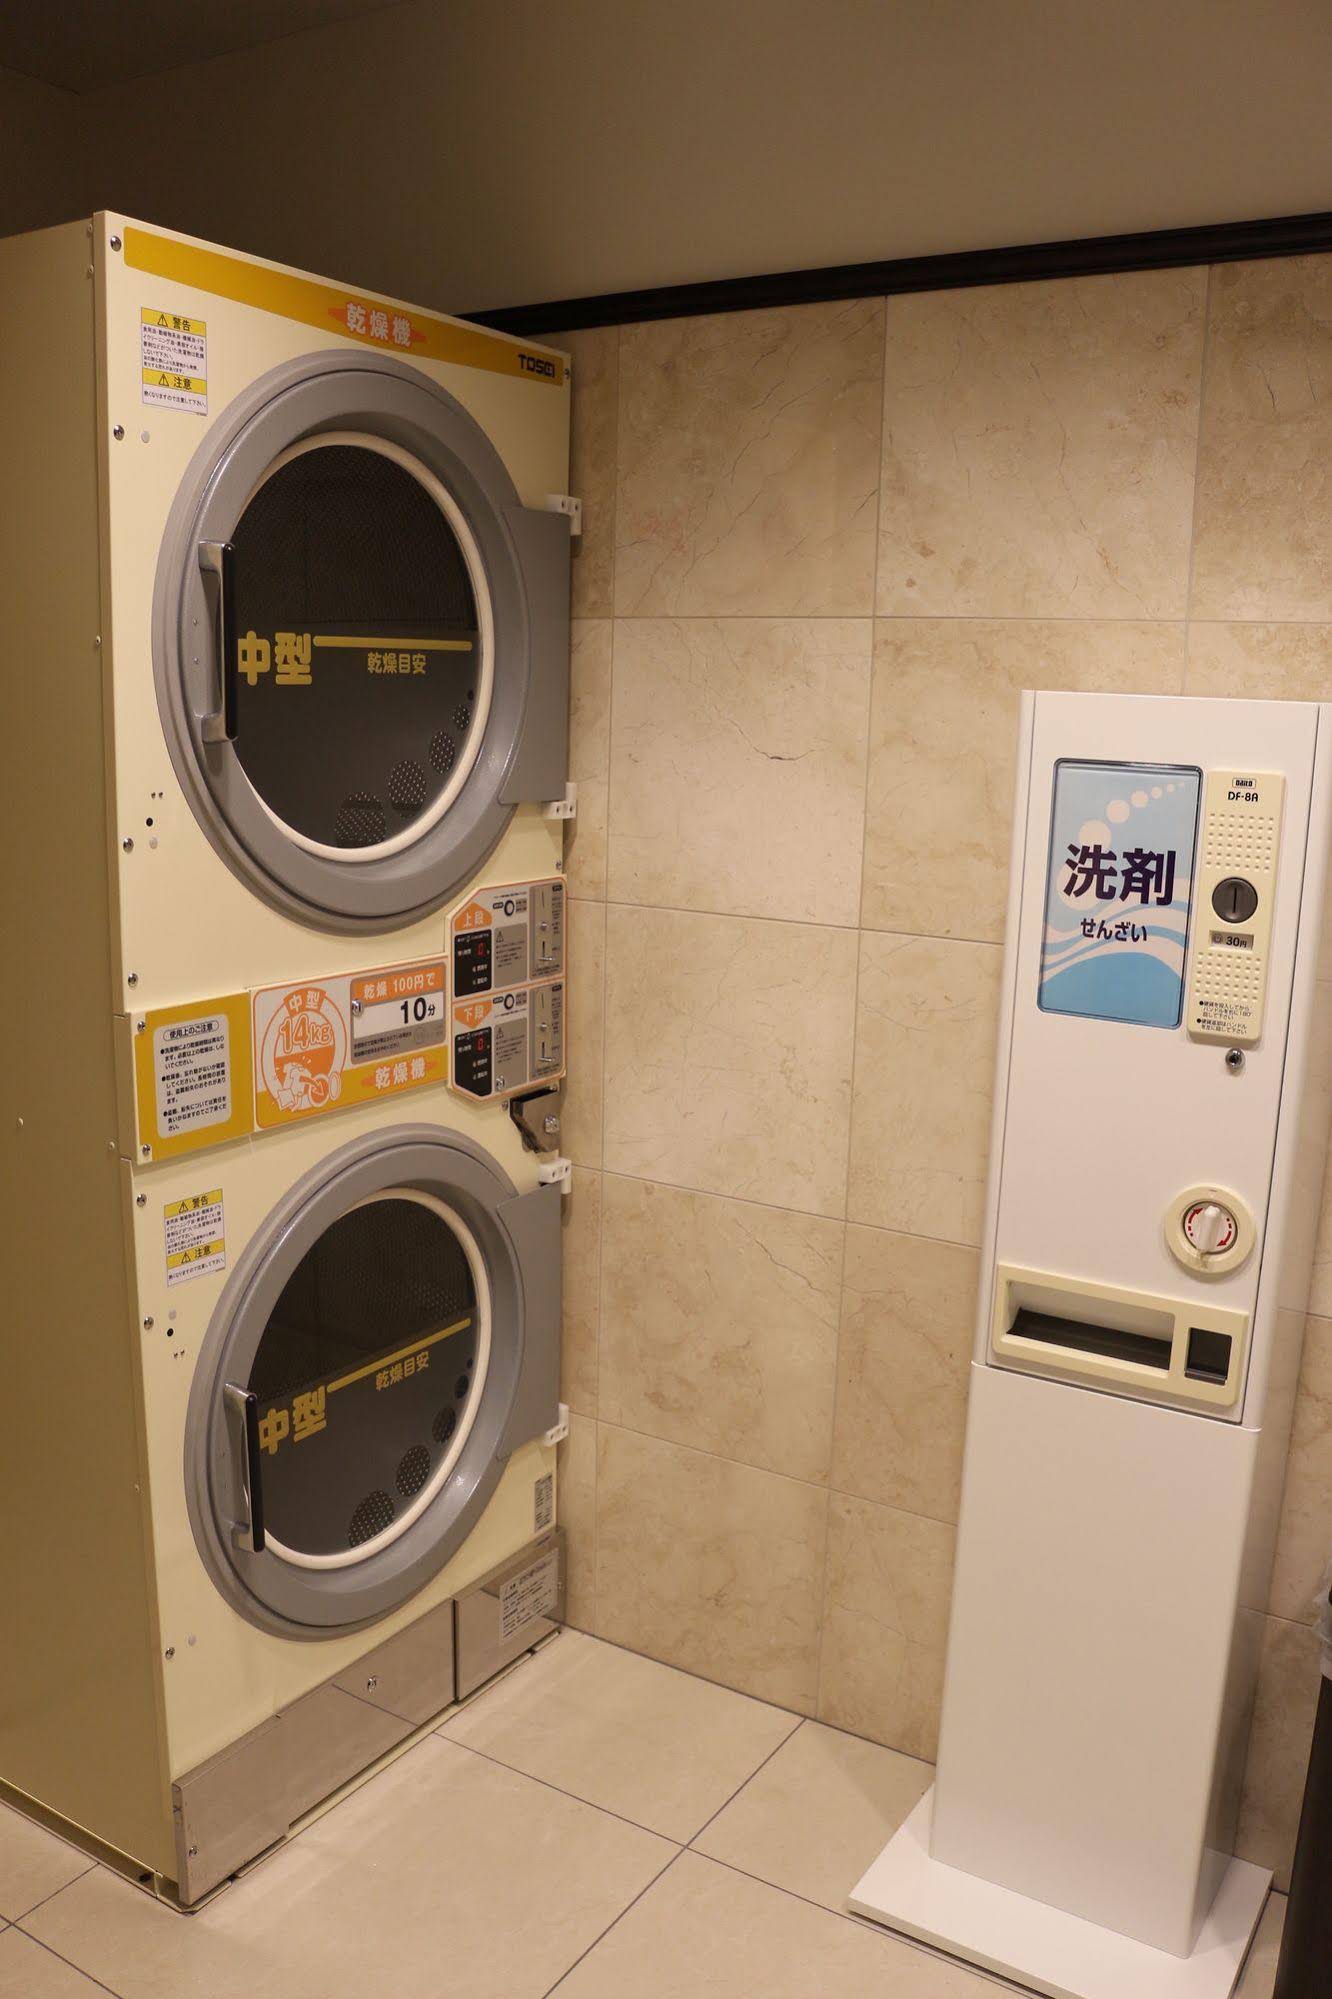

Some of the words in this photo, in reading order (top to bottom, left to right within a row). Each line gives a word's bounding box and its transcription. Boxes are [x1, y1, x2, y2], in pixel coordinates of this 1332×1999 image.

[173, 317, 191, 332] 警告
[346, 303, 412, 347] 乾燥機
[173, 376, 192, 390] 注意
[238, 630, 312, 687] 中型
[367, 652, 426, 675] 乾燥目安
[1227, 791, 1259, 802] DF-8A
[1062, 844, 1177, 906] 洗剤
[463, 910, 485, 929] 上段
[1080, 918, 1148, 942] せんざい
[363, 981, 388, 1000] 乾燥
[393, 973, 436, 993] 100円で
[288, 990, 321, 1012] 中型
[400, 997, 436, 1024] 10分
[464, 1005, 485, 1022] 下段
[477, 1038, 486, 1051] 0
[375, 1057, 426, 1089] 乾燥機
[194, 1245, 211, 1258] 注意
[375, 1352, 429, 1391] 乾燥目安
[259, 1385, 327, 1455] 中型
